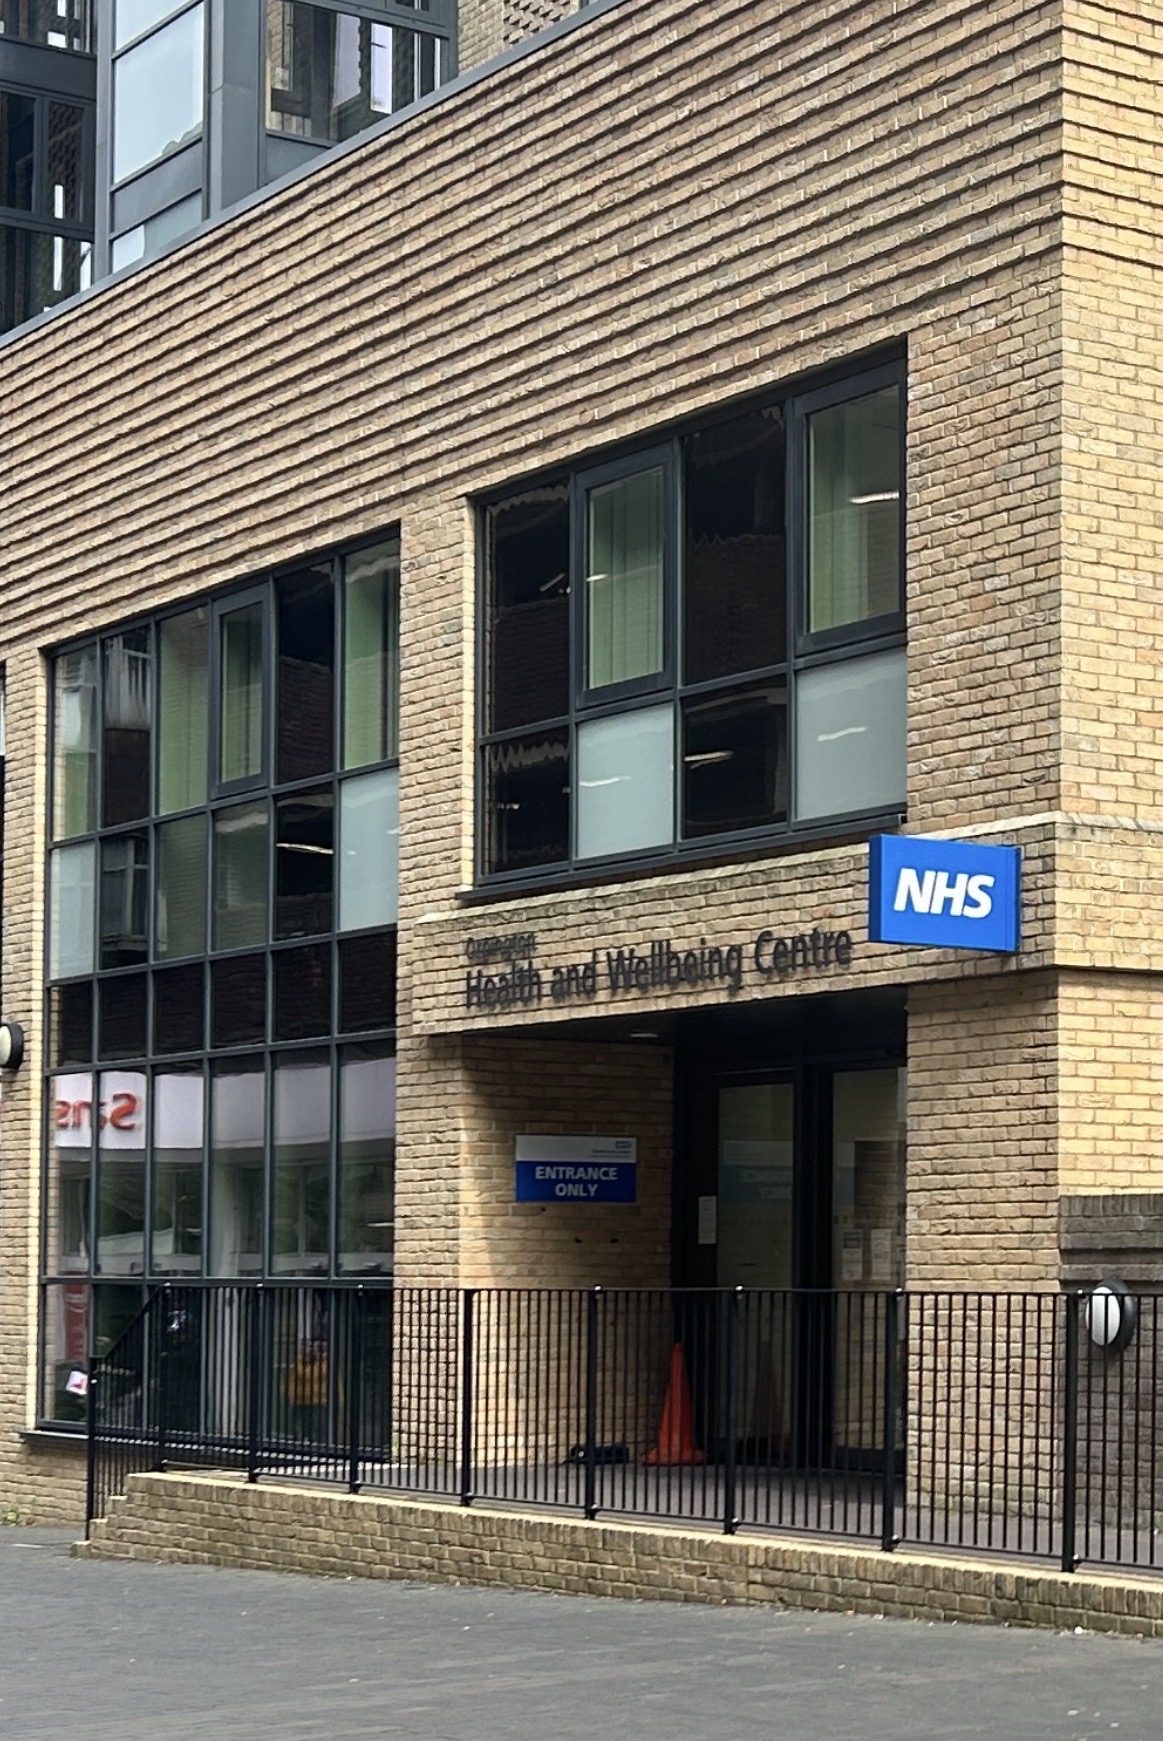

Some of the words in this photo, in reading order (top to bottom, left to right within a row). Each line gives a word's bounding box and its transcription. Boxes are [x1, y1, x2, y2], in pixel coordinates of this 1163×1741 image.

[893, 867, 995, 919] NHS
[466, 961, 542, 1008] Health
[550, 950, 598, 1002] and
[606, 939, 743, 993] Wellbeing
[754, 927, 853, 976] Centre
[535, 1166, 618, 1181] ENTRANCE
[554, 1183, 599, 1197] ONLY
